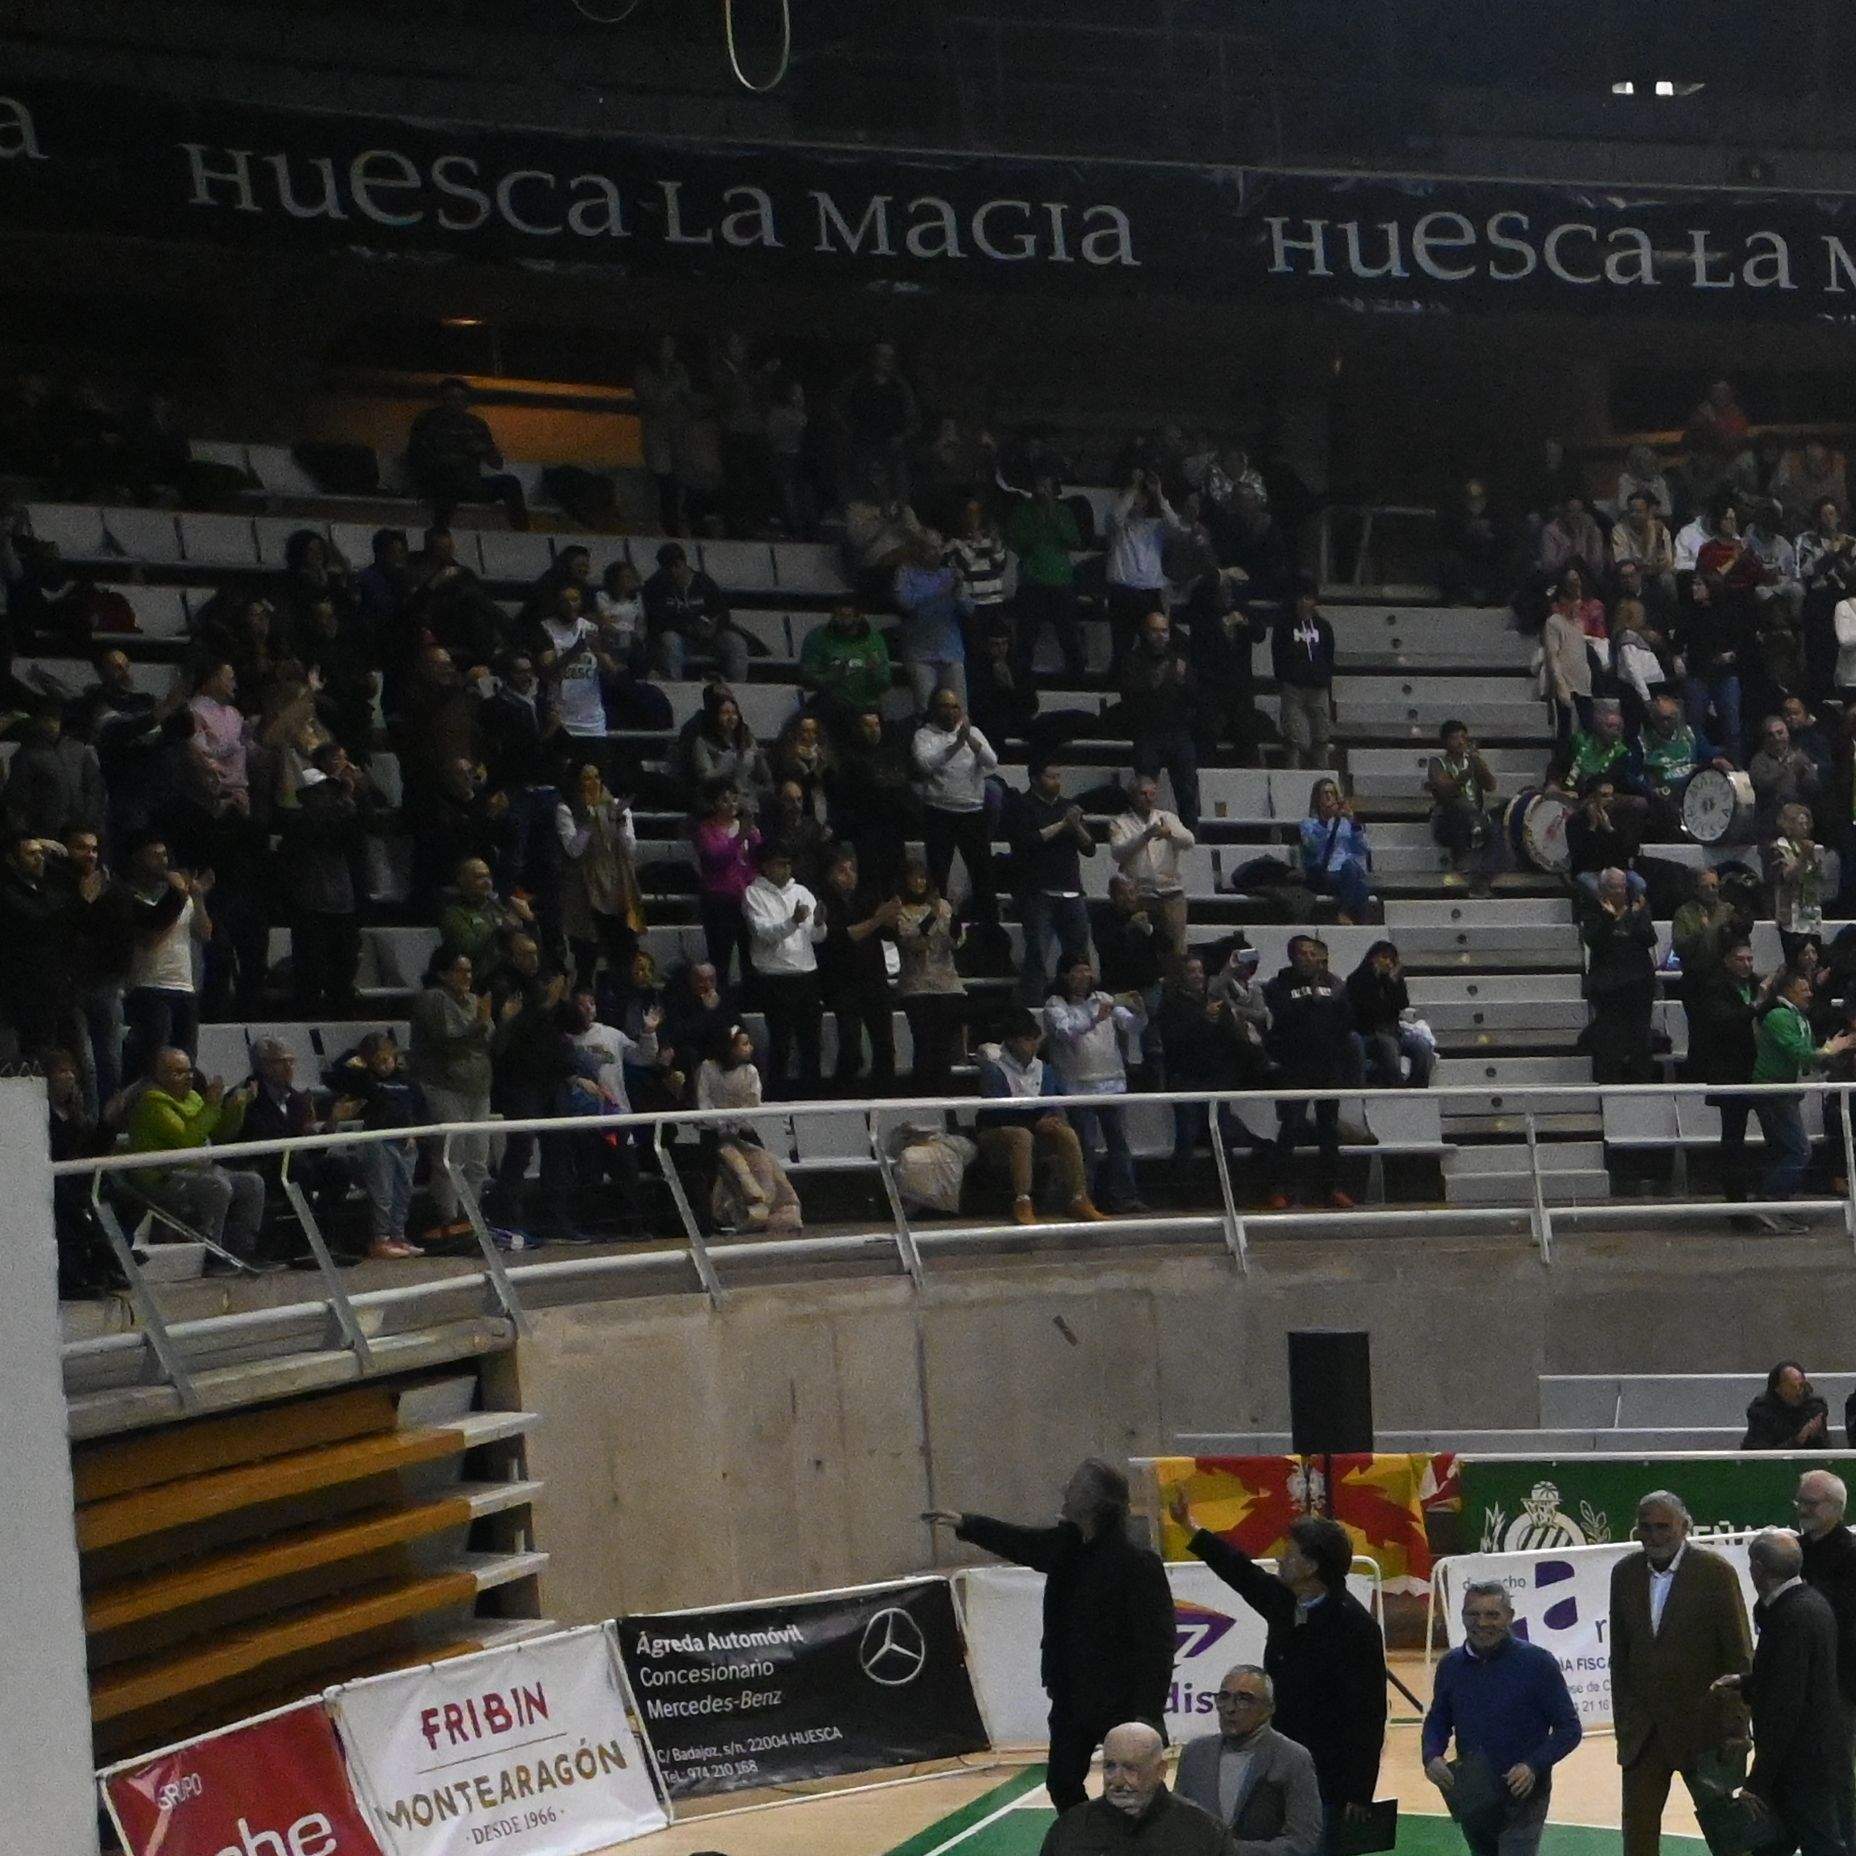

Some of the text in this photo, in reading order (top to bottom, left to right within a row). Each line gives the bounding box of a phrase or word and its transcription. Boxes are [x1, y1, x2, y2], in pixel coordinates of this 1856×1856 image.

[708, 1624, 804, 1652] Automóvil
[640, 1658, 775, 1688] Concesionario
[420, 1681, 550, 1750] FRIBIN
[647, 1690, 782, 1720] Mercedes-Benz
[749, 1734, 788, 1753] 22004
[790, 1726, 843, 1747] HUESCA
[385, 1737, 628, 1831] MONTEARAGÓN
[687, 1763, 712, 1779] 974
[713, 1762, 734, 1778] 210
[471, 1807, 558, 1845] DESDE 1966
